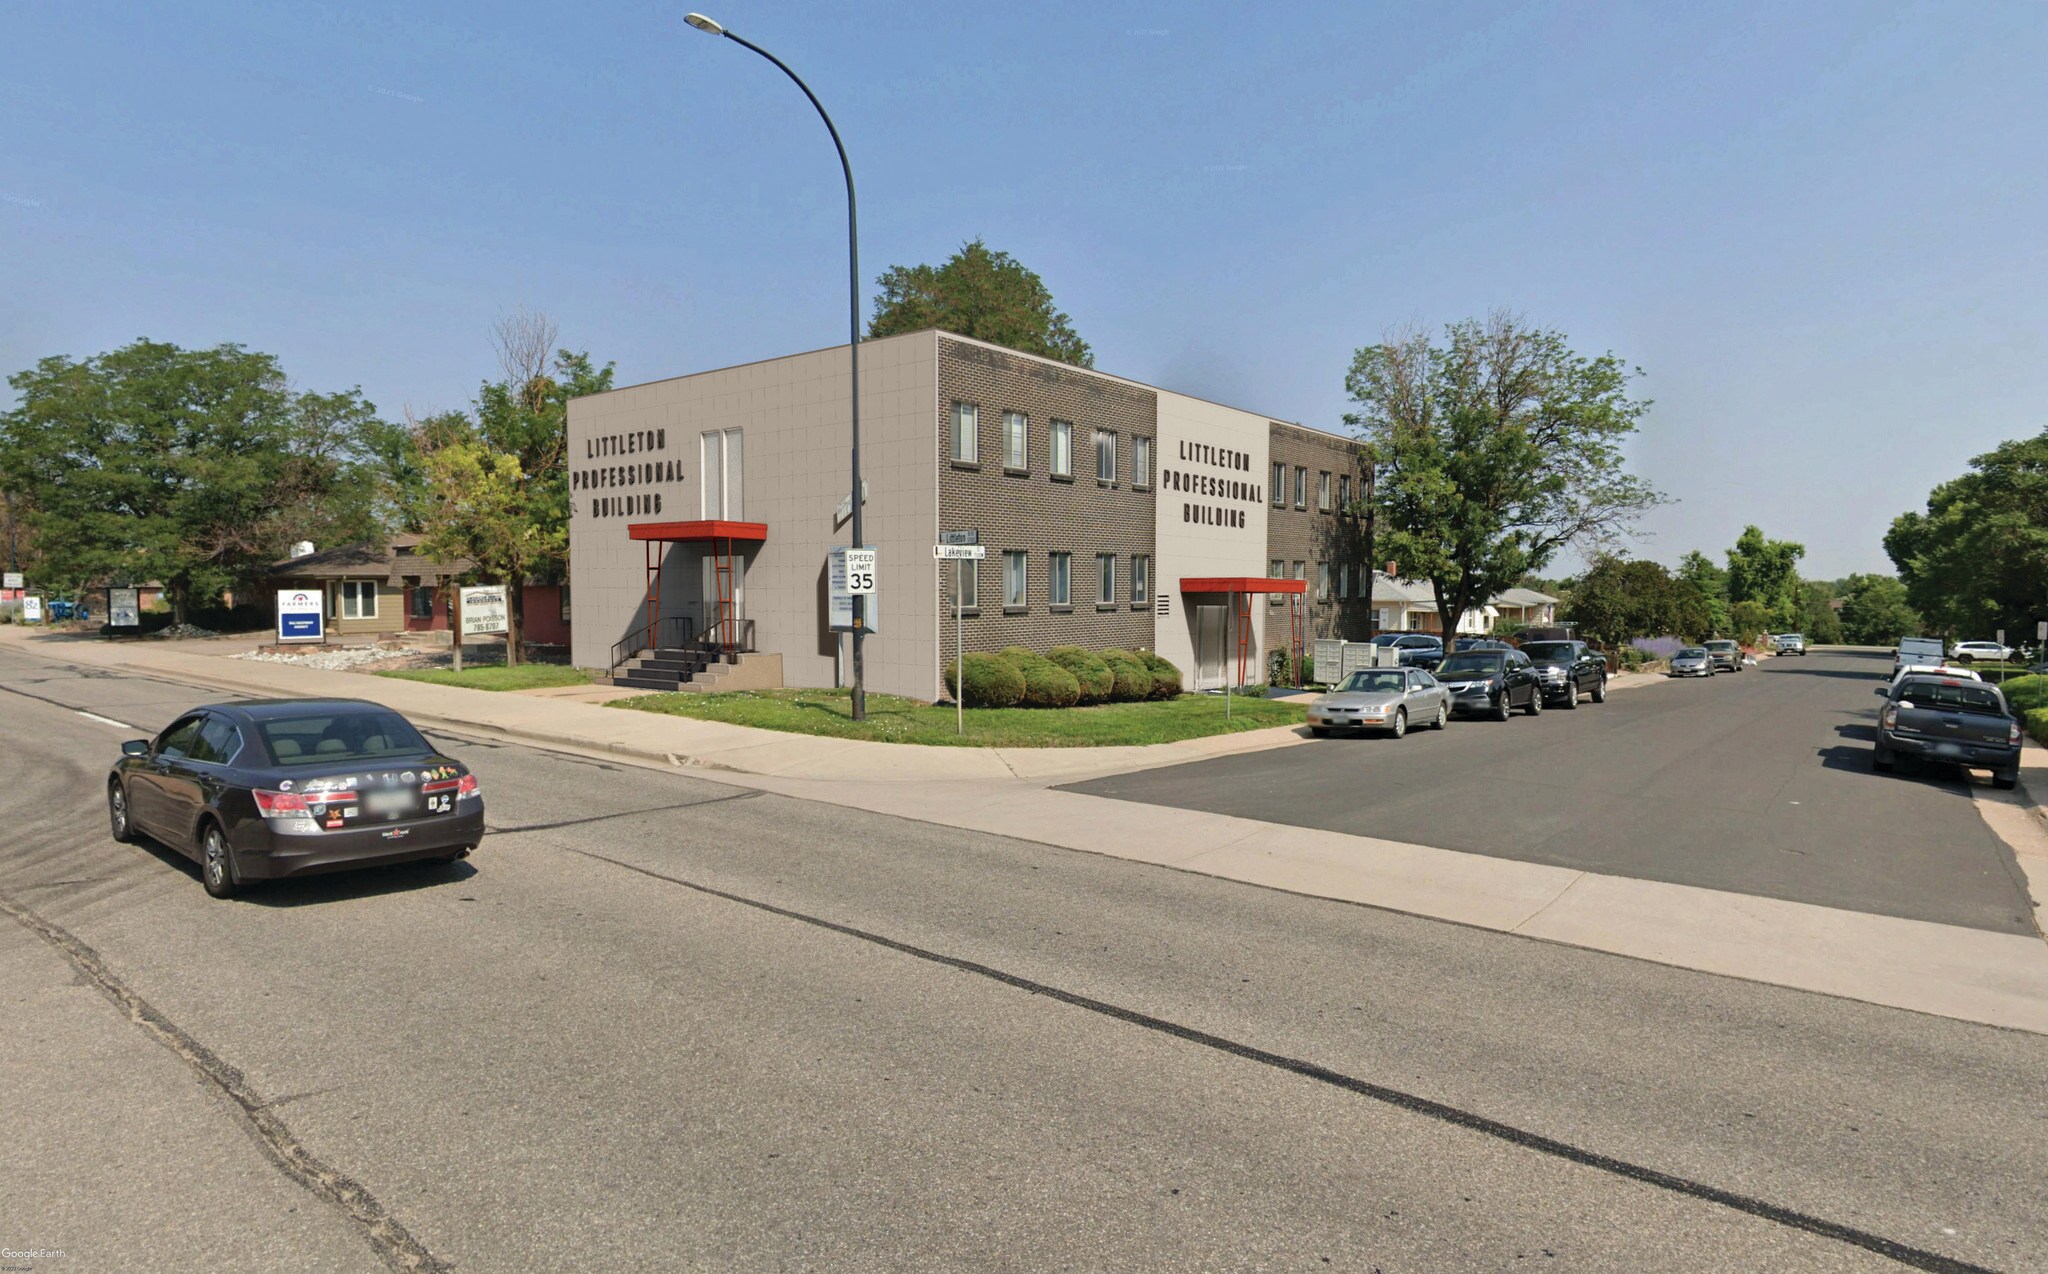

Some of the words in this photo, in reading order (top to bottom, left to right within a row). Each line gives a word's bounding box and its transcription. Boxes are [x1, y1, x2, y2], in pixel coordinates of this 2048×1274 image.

[587, 428, 665, 459] LITTLETON
[1180, 440, 1249, 472] LITTLETON
[573, 459, 685, 491] PROFESSIONAL
[1163, 469, 1262, 503] PROFESSIONAL
[592, 493, 662, 519] BUILDING
[1183, 503, 1245, 529] BUILDING
[848, 554, 874, 562] SPEED
[945, 547, 972, 558] Lakeview
[851, 563, 871, 571] LIMIT
[850, 573, 873, 590] 35
[465, 616, 481, 625] BRIAN
